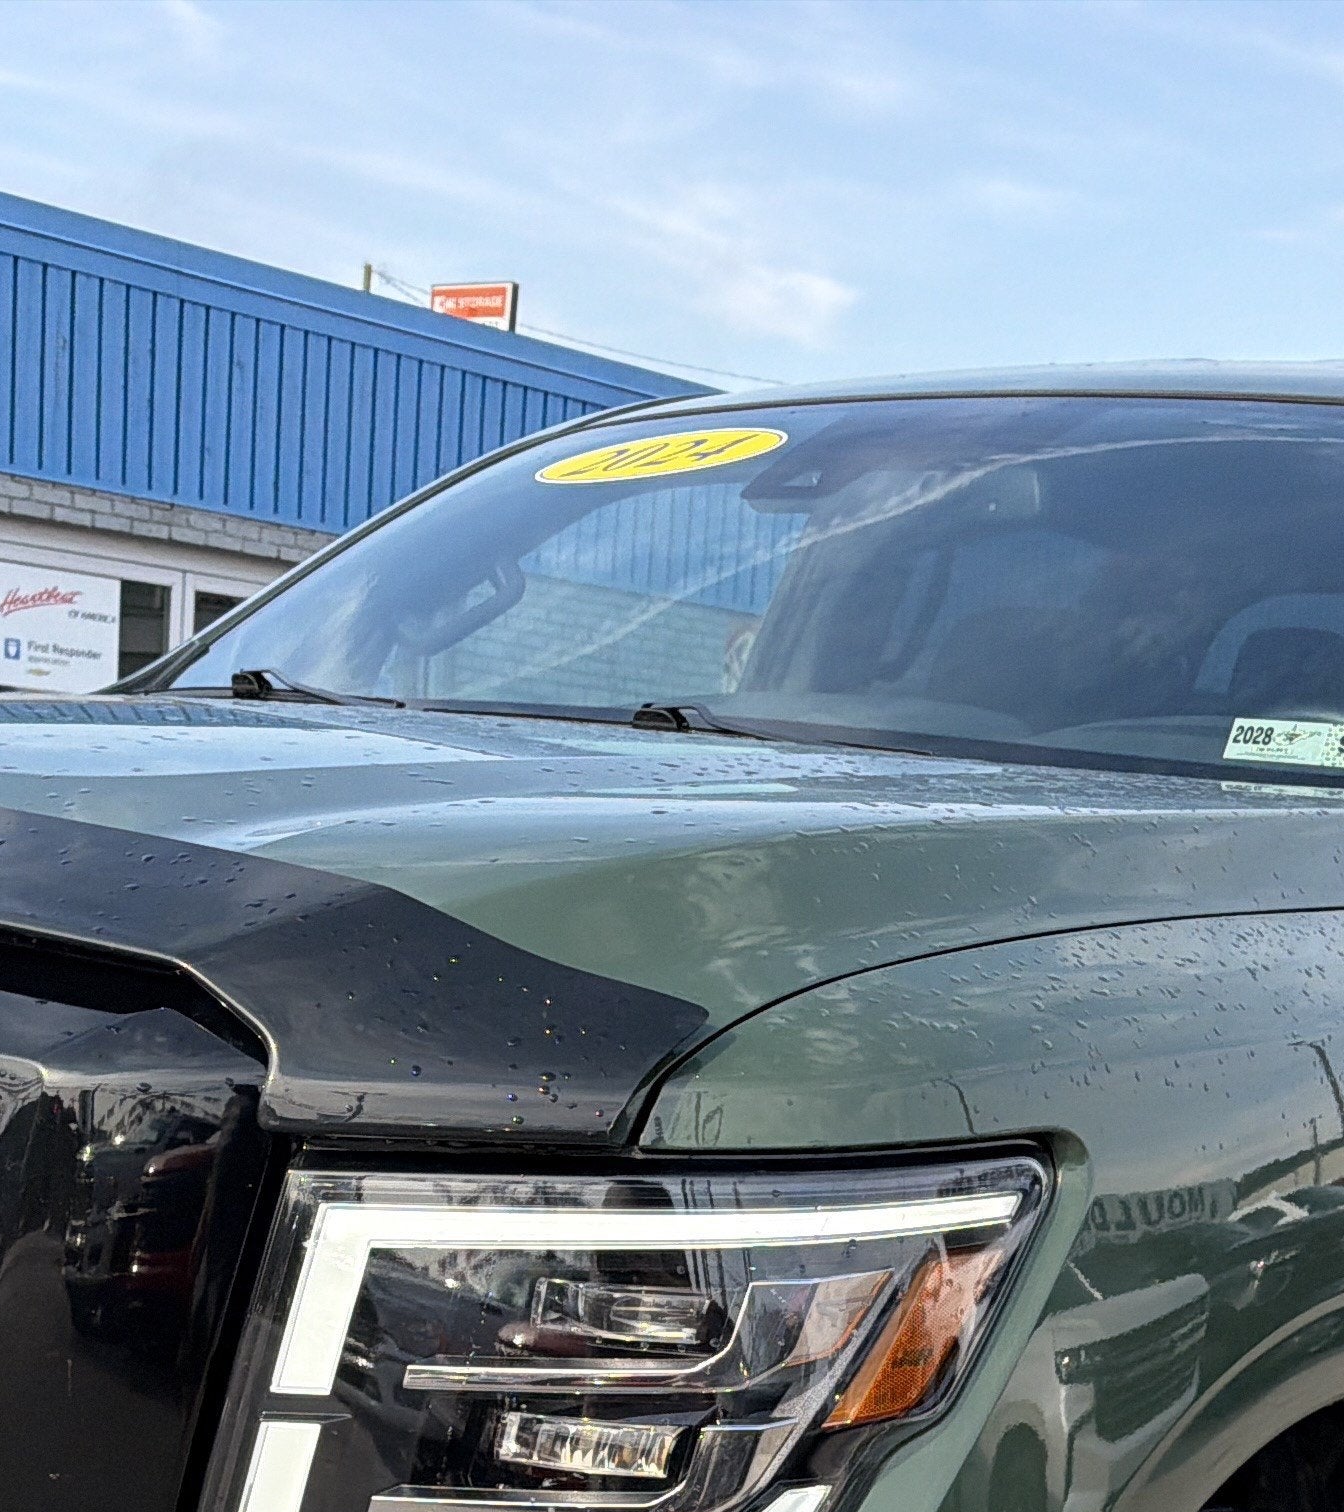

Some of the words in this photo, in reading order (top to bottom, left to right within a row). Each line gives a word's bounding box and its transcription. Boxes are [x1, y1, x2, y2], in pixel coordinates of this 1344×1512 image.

[557, 433, 761, 478] 2024
[27, 640, 50, 653] First
[1231, 725, 1275, 746] 2028
